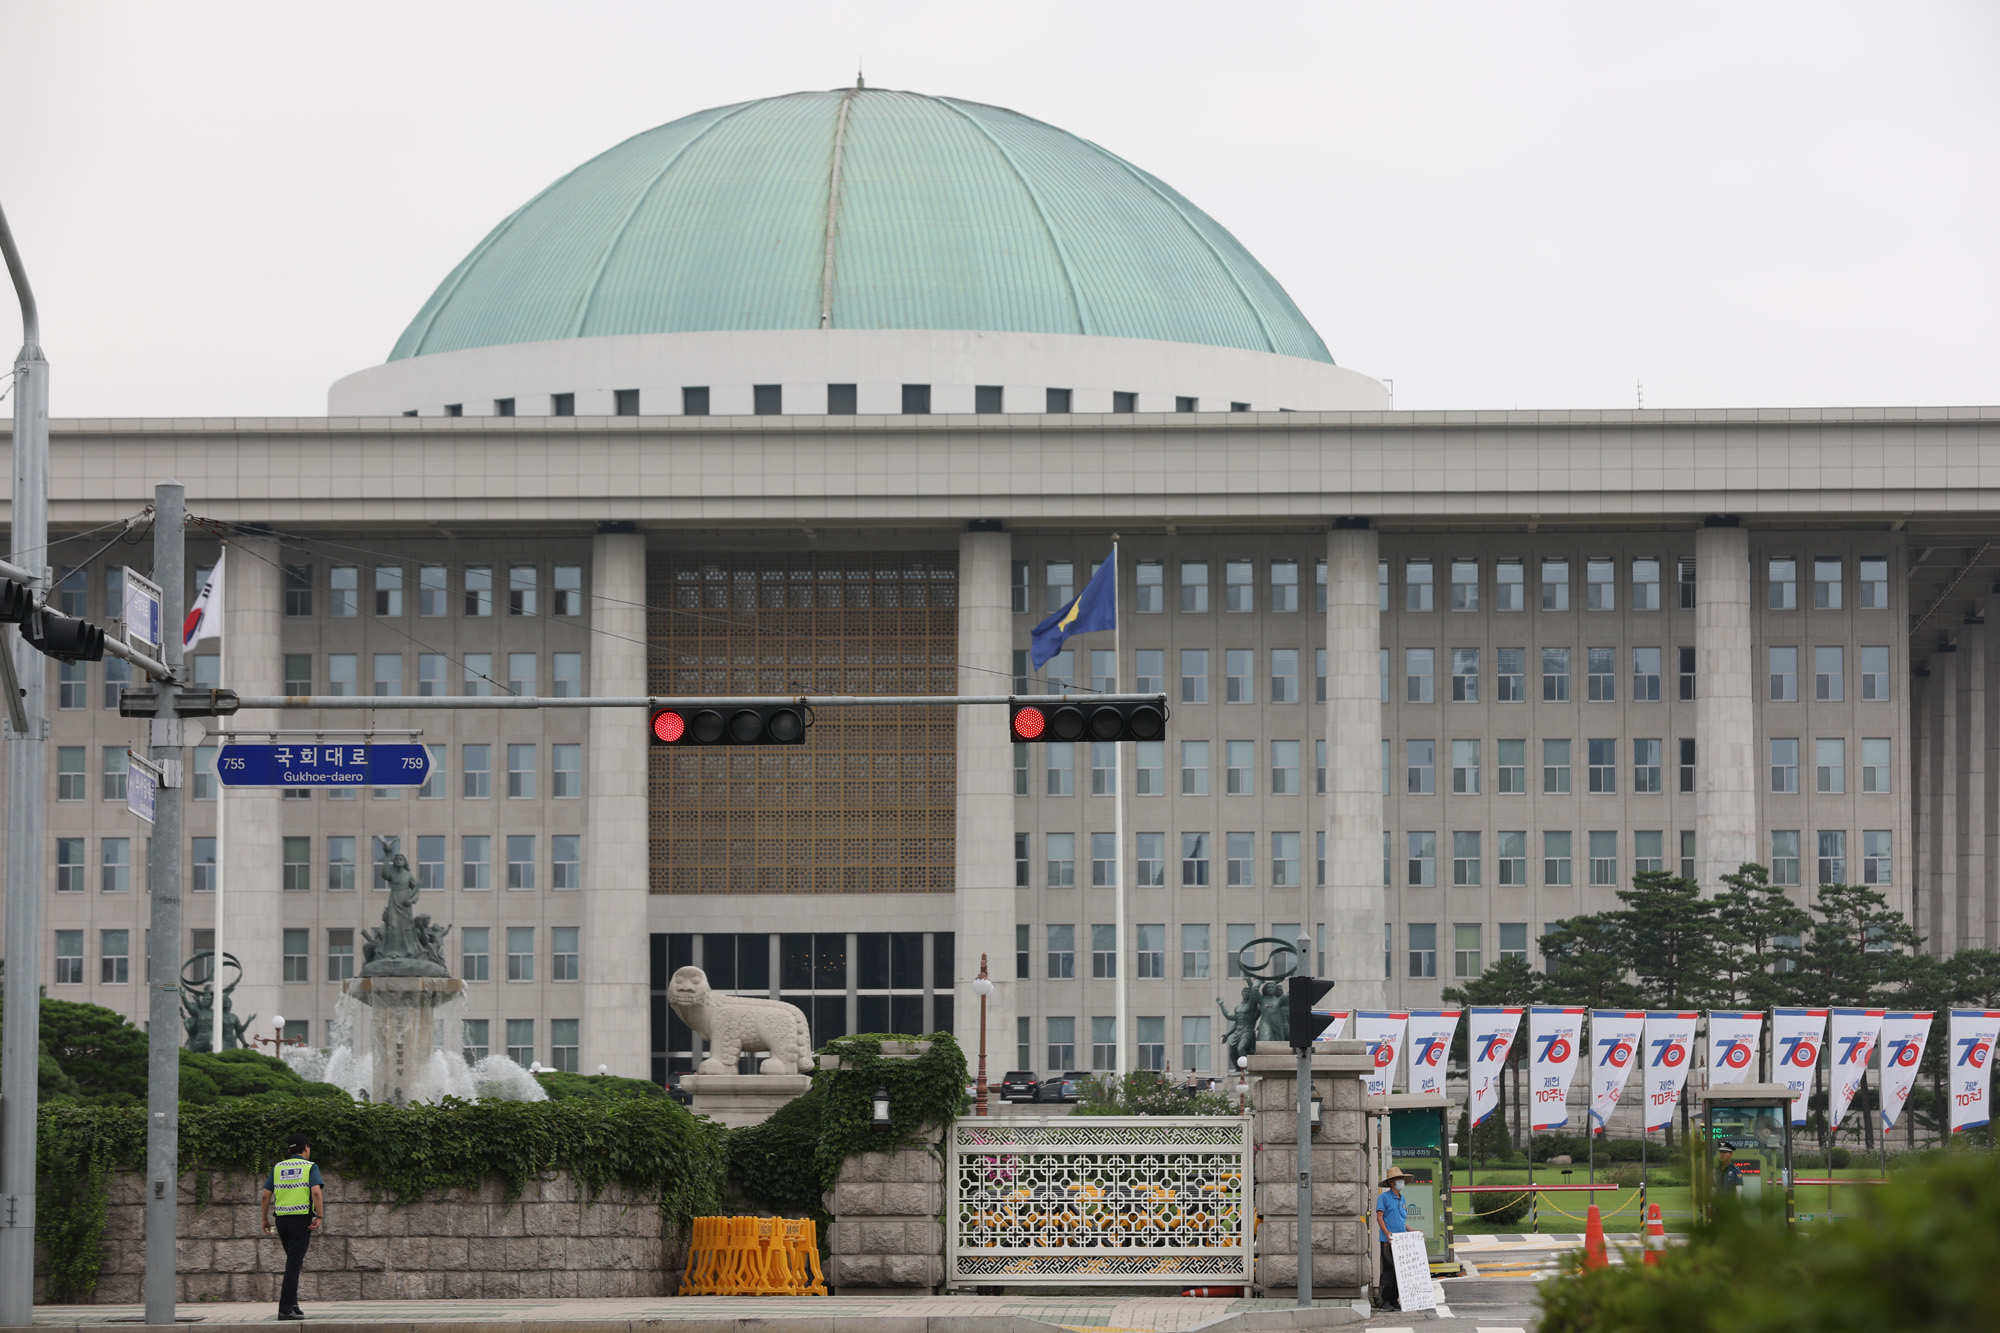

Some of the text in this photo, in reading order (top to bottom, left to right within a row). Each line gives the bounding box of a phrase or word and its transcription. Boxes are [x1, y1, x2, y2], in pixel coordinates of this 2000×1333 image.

[223, 758, 246, 769] 755
[274, 747, 369, 767] 국회대로
[401, 757, 424, 769] 759
[283, 771, 364, 782] Gukhoe-daero
[1536, 1034, 1571, 1063] 70
[1598, 1039, 1634, 1068] 70
[1651, 1039, 1686, 1068] 70
[1715, 1039, 1752, 1069] 70
[1779, 1037, 1817, 1068] 70
[1887, 1039, 1920, 1068] 70
[1957, 1037, 1990, 1069] 70
[1368, 1080, 1384, 1092] 제헌
[1543, 1076, 1560, 1088] 제헌
[1788, 1081, 1805, 1091] 제헌
